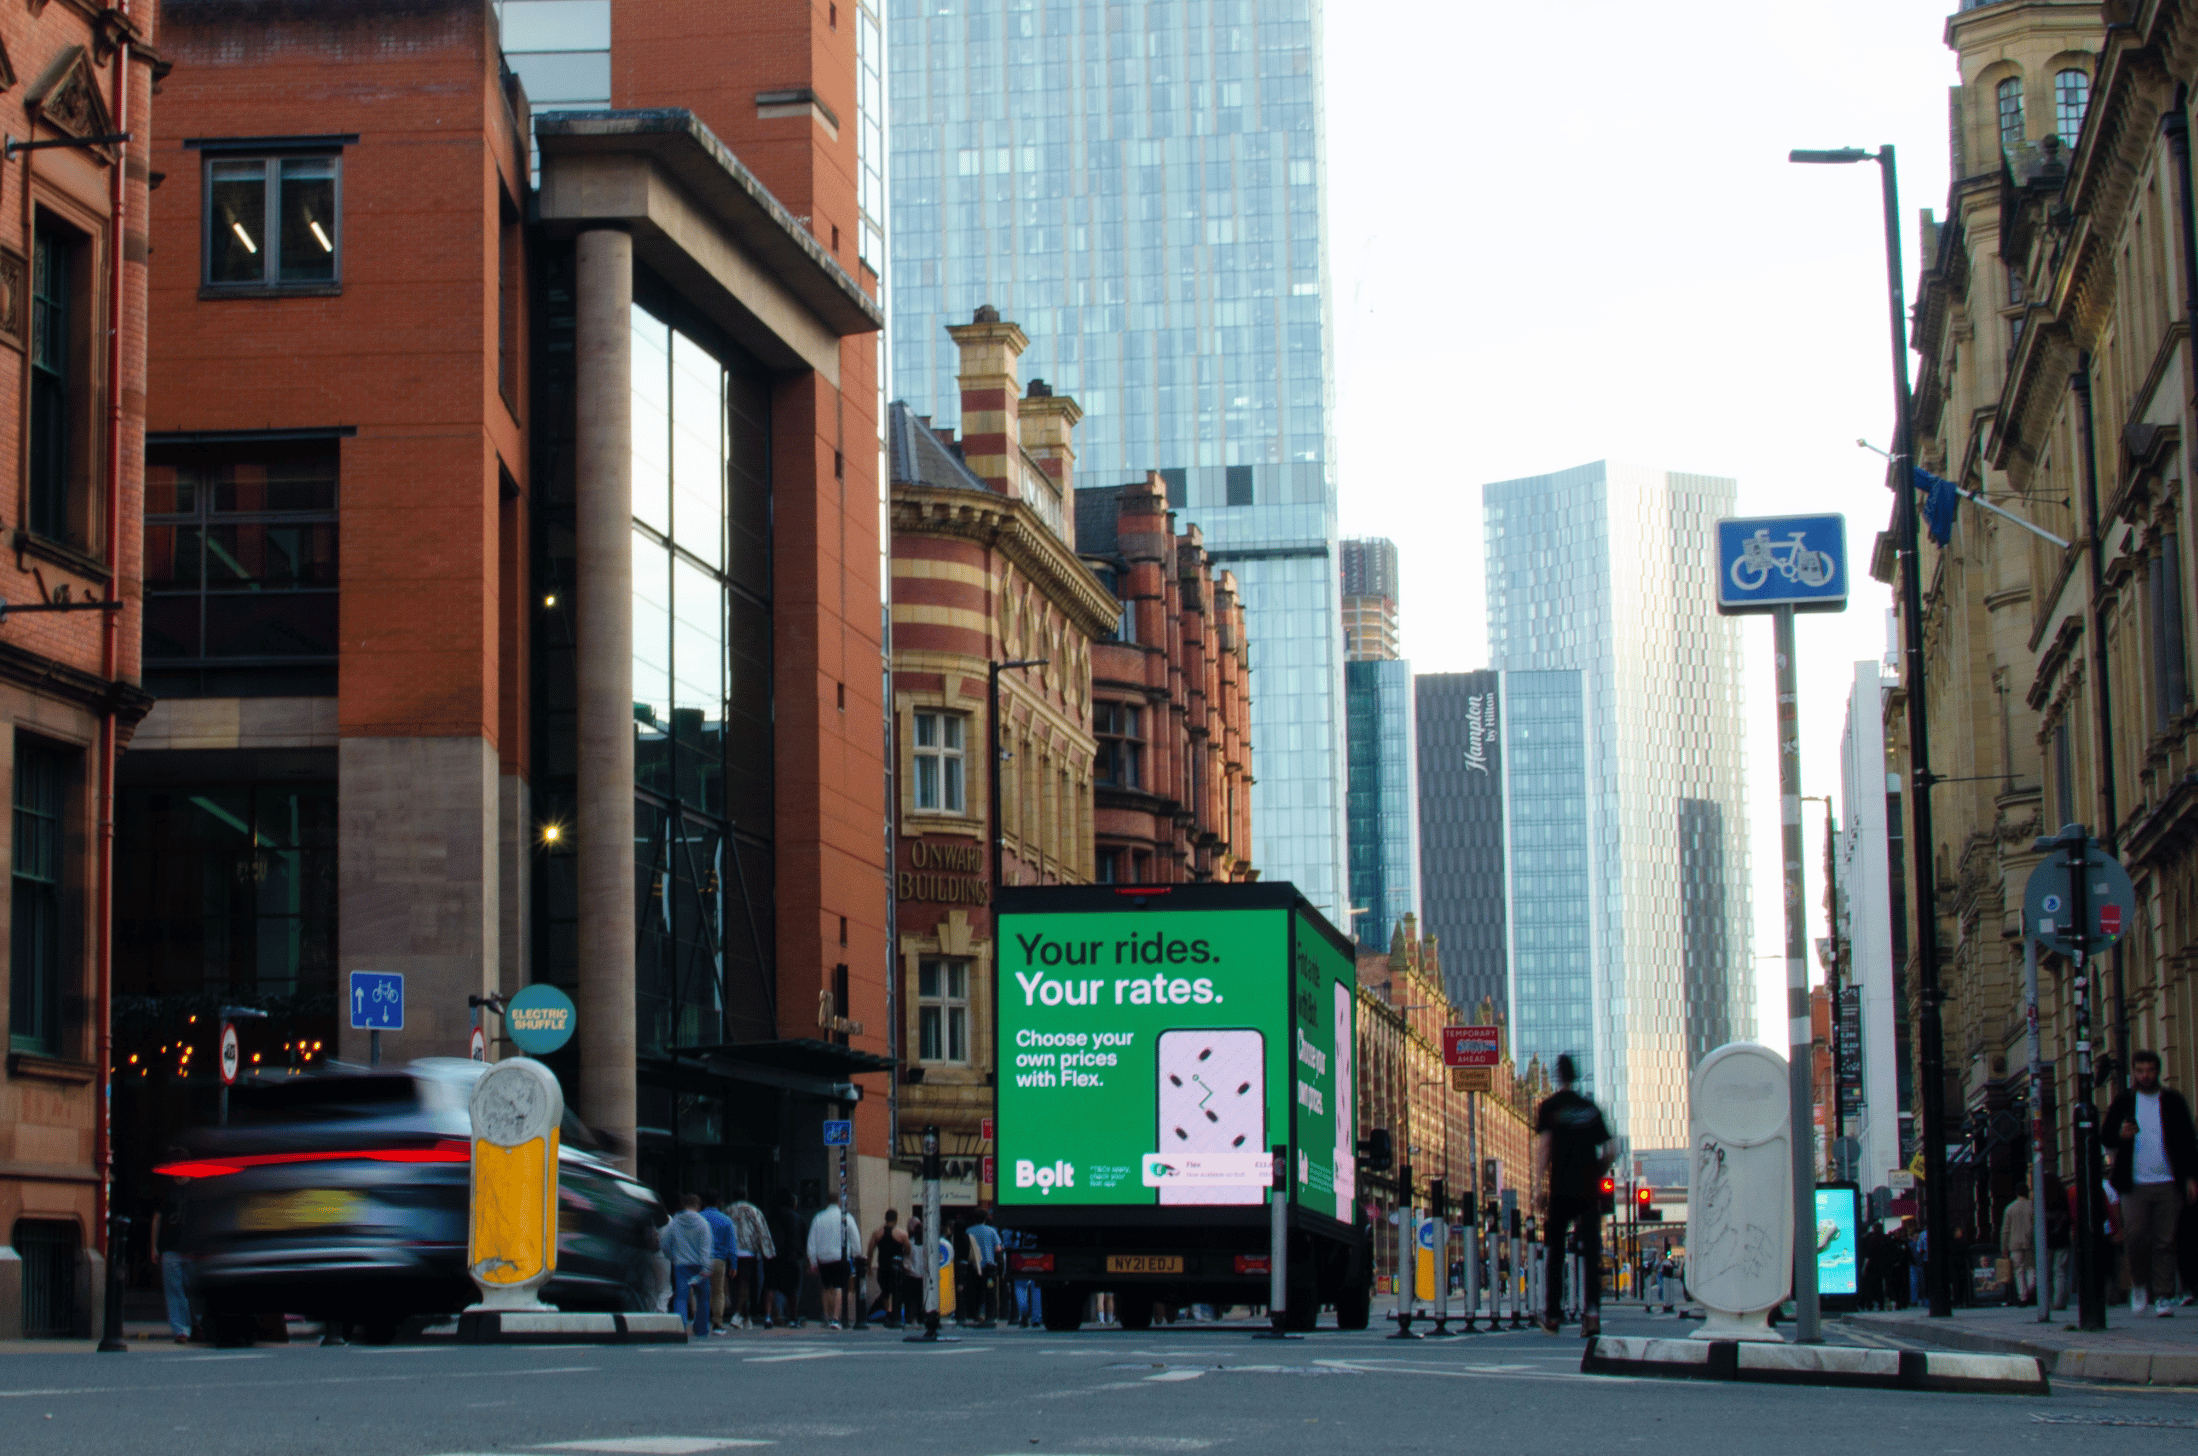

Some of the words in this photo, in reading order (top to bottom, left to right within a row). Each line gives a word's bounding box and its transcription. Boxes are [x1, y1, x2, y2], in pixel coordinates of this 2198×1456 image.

[1485, 692, 1496, 727] Hilton
[1464, 693, 1489, 776] Hampton
[1485, 728, 1498, 742] by
[1015, 932, 1104, 966] Your
[1115, 931, 1221, 965] rides.
[1015, 970, 1105, 1006] Your
[1114, 971, 1224, 1005] rates.
[512, 1008, 568, 1020] ELECTRIC
[514, 1019, 566, 1031] SHUFFLE
[1016, 1028, 1088, 1047] Choose
[1091, 1032, 1135, 1051] your
[1445, 1029, 1496, 1038] TEMPORARY
[1016, 1053, 1056, 1067] own
[1060, 1049, 1118, 1071] prices
[1458, 1055, 1486, 1063] AHEAD
[1016, 1070, 1057, 1087] with
[1060, 1069, 1104, 1087] Flex.
[1016, 1159, 1075, 1195] Bolt
